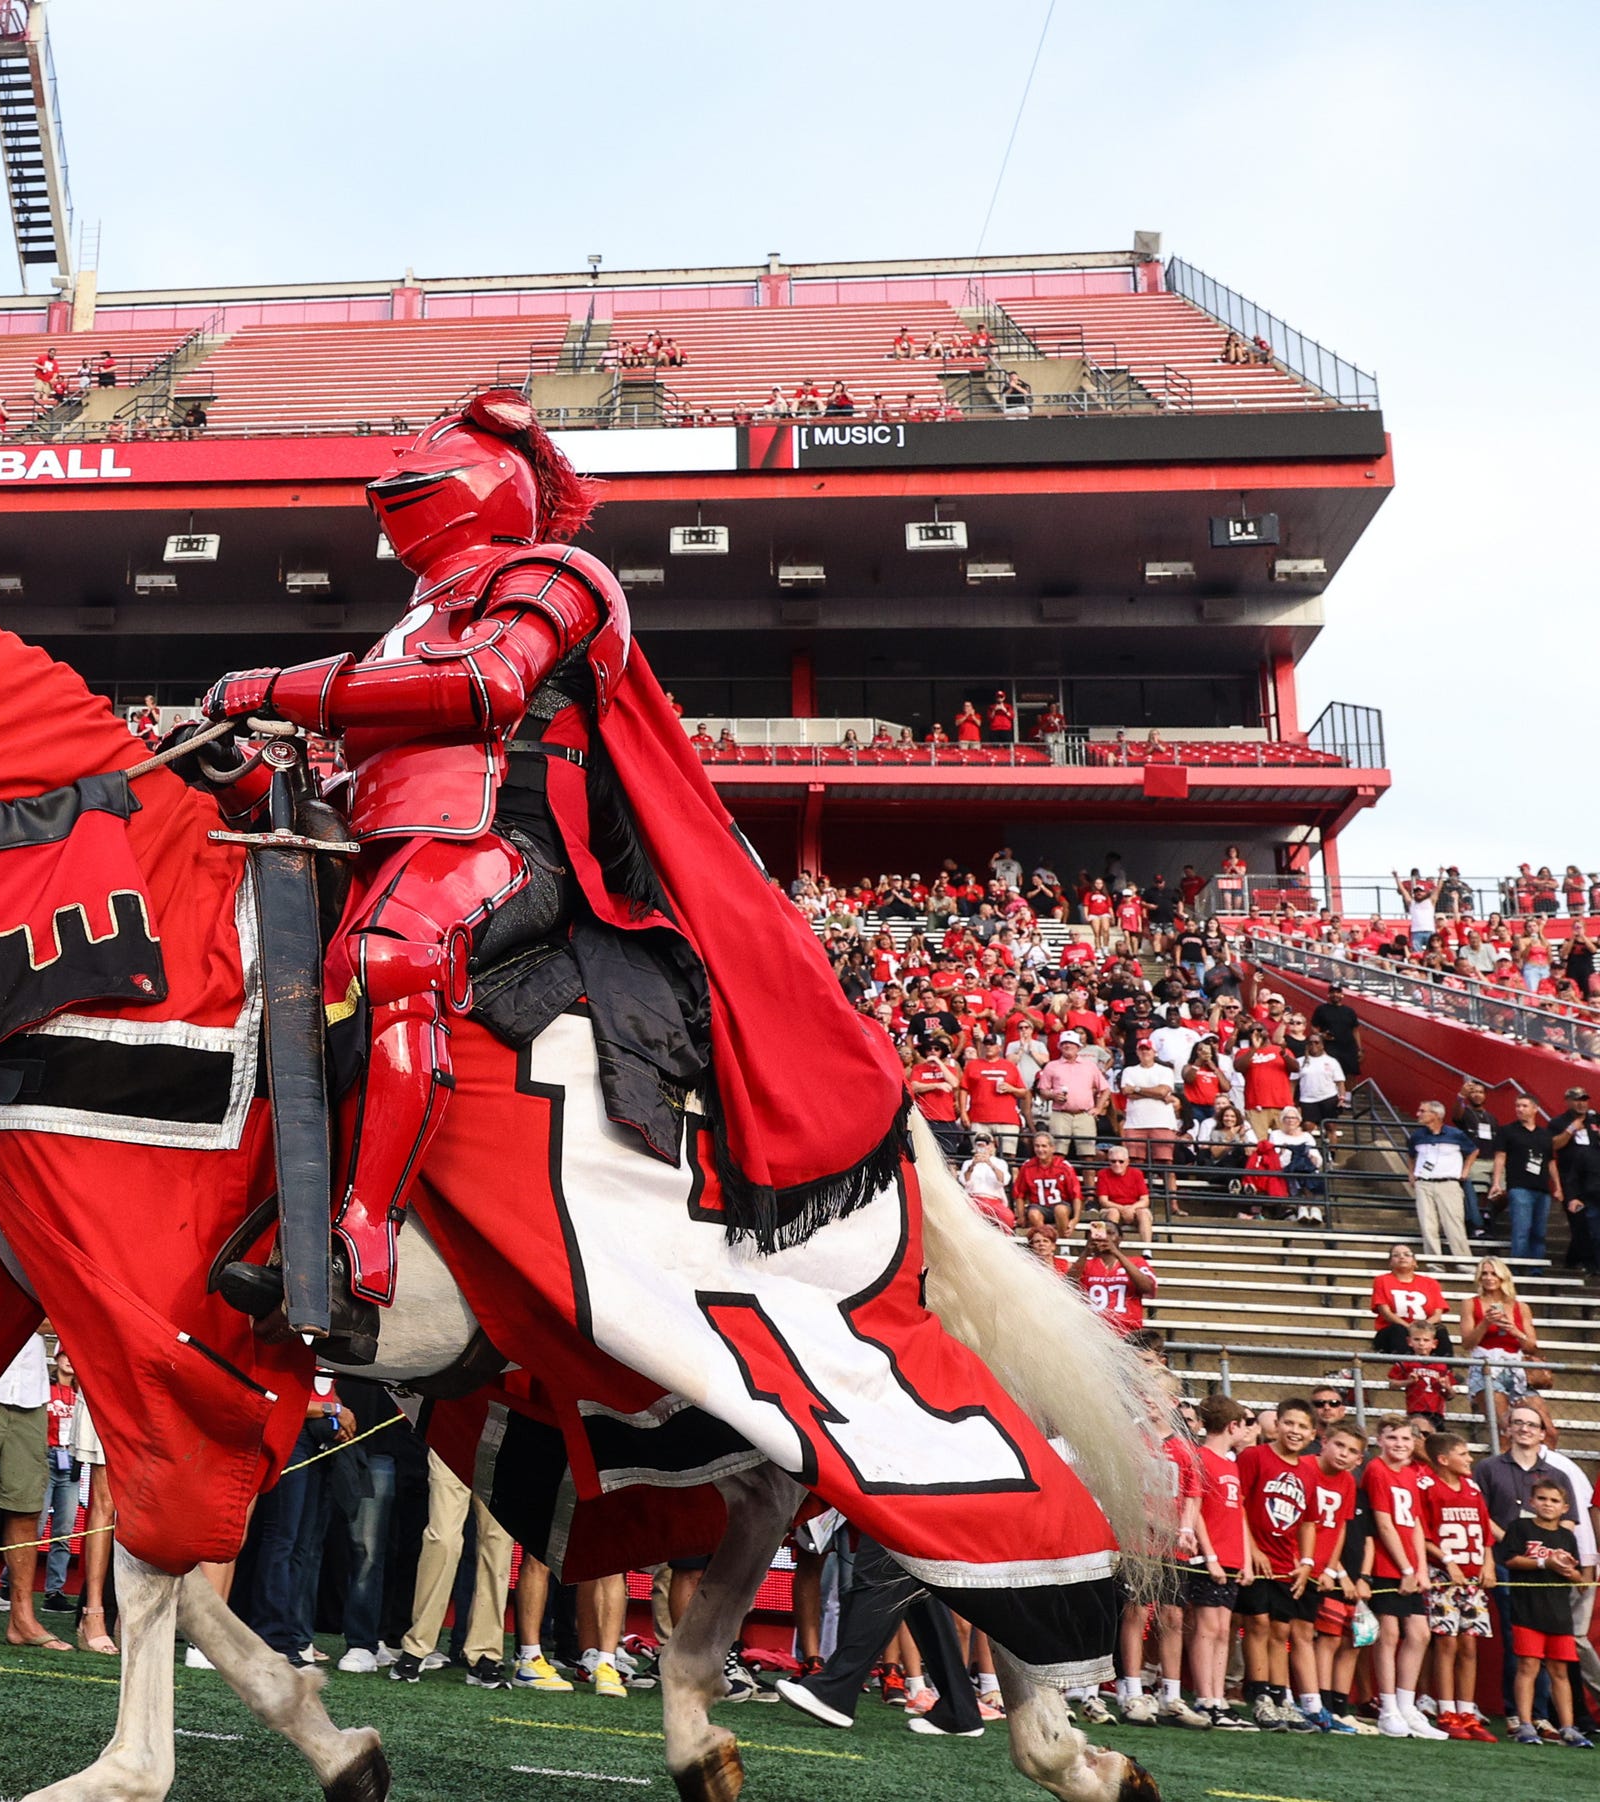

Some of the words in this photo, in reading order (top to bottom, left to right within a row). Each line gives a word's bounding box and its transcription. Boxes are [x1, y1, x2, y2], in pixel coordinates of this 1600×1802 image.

[814, 426, 891, 446] MUSIC
[924, 1017, 941, 1029] R
[1033, 1178, 1062, 1205] 13
[1089, 1284, 1128, 1314] 97
[1390, 1289, 1427, 1321] R
[1226, 1484, 1239, 1501] R
[1263, 1480, 1307, 1511] GIANTS
[1316, 1486, 1343, 1529] R
[1390, 1486, 1416, 1528] R
[1441, 1507, 1480, 1522] RUTGERS
[1438, 1523, 1485, 1566] 23
